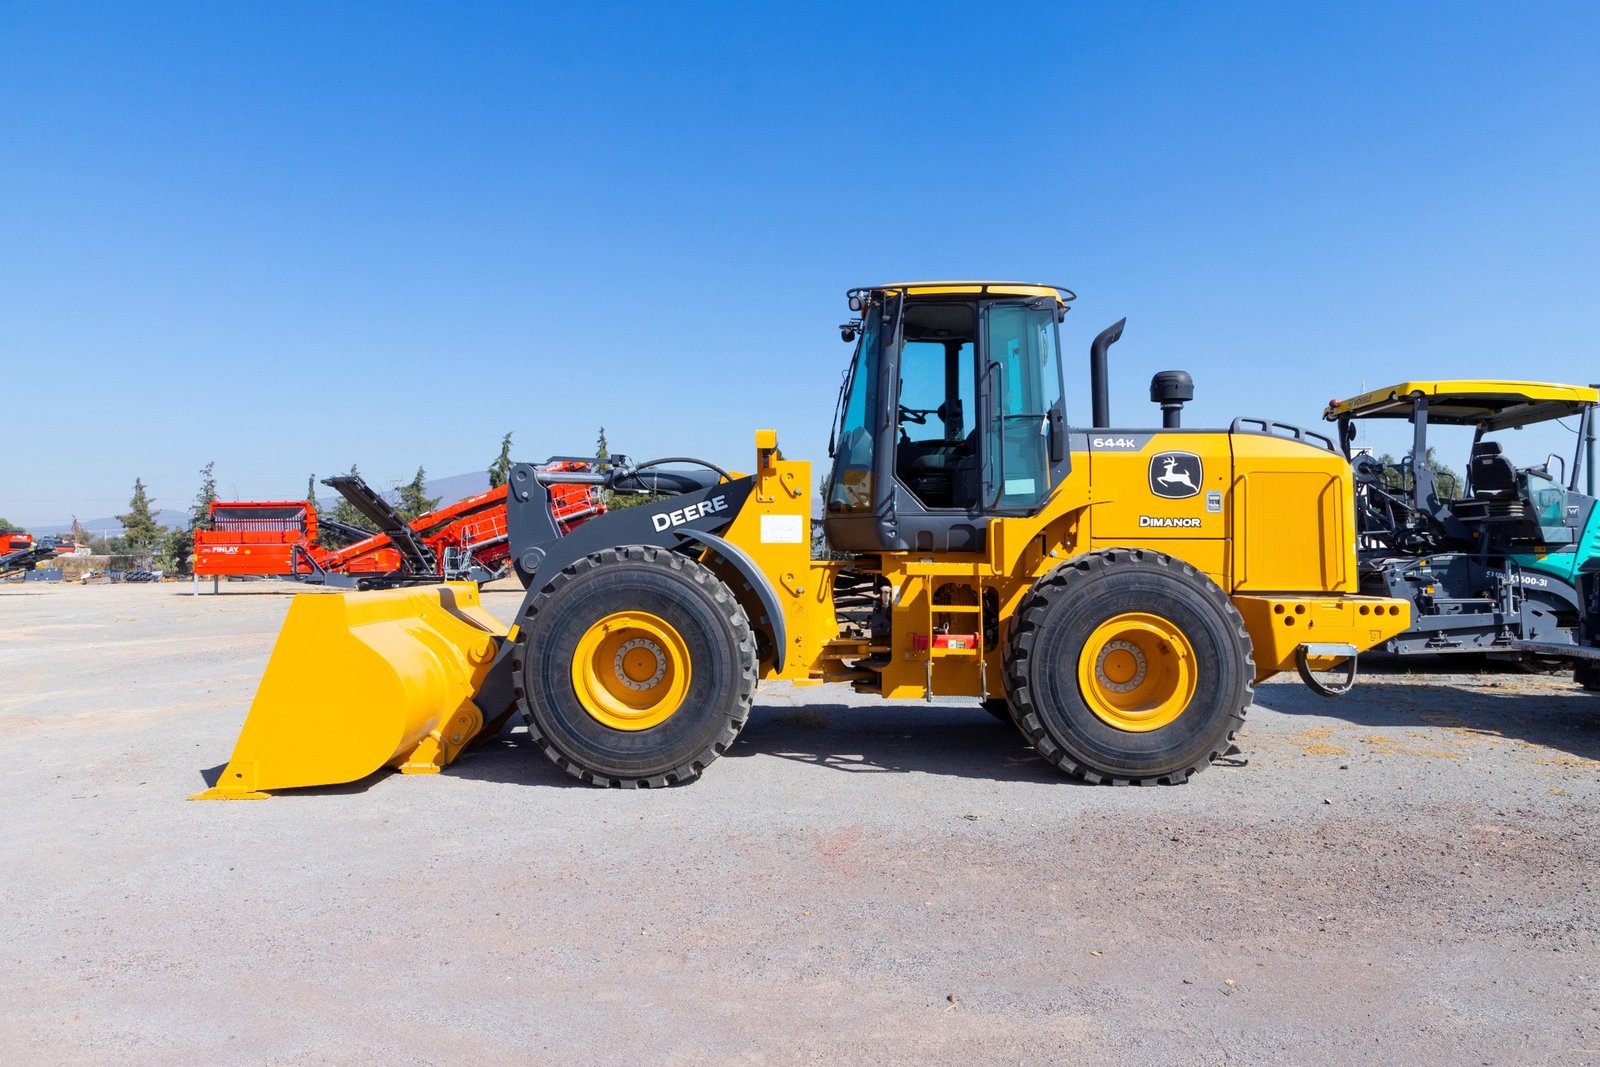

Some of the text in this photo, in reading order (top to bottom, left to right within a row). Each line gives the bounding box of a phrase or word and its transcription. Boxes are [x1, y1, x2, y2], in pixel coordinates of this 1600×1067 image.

[1093, 438, 1136, 448] 644K
[651, 494, 729, 533] DEERE
[1139, 515, 1202, 527] DIMANOR
